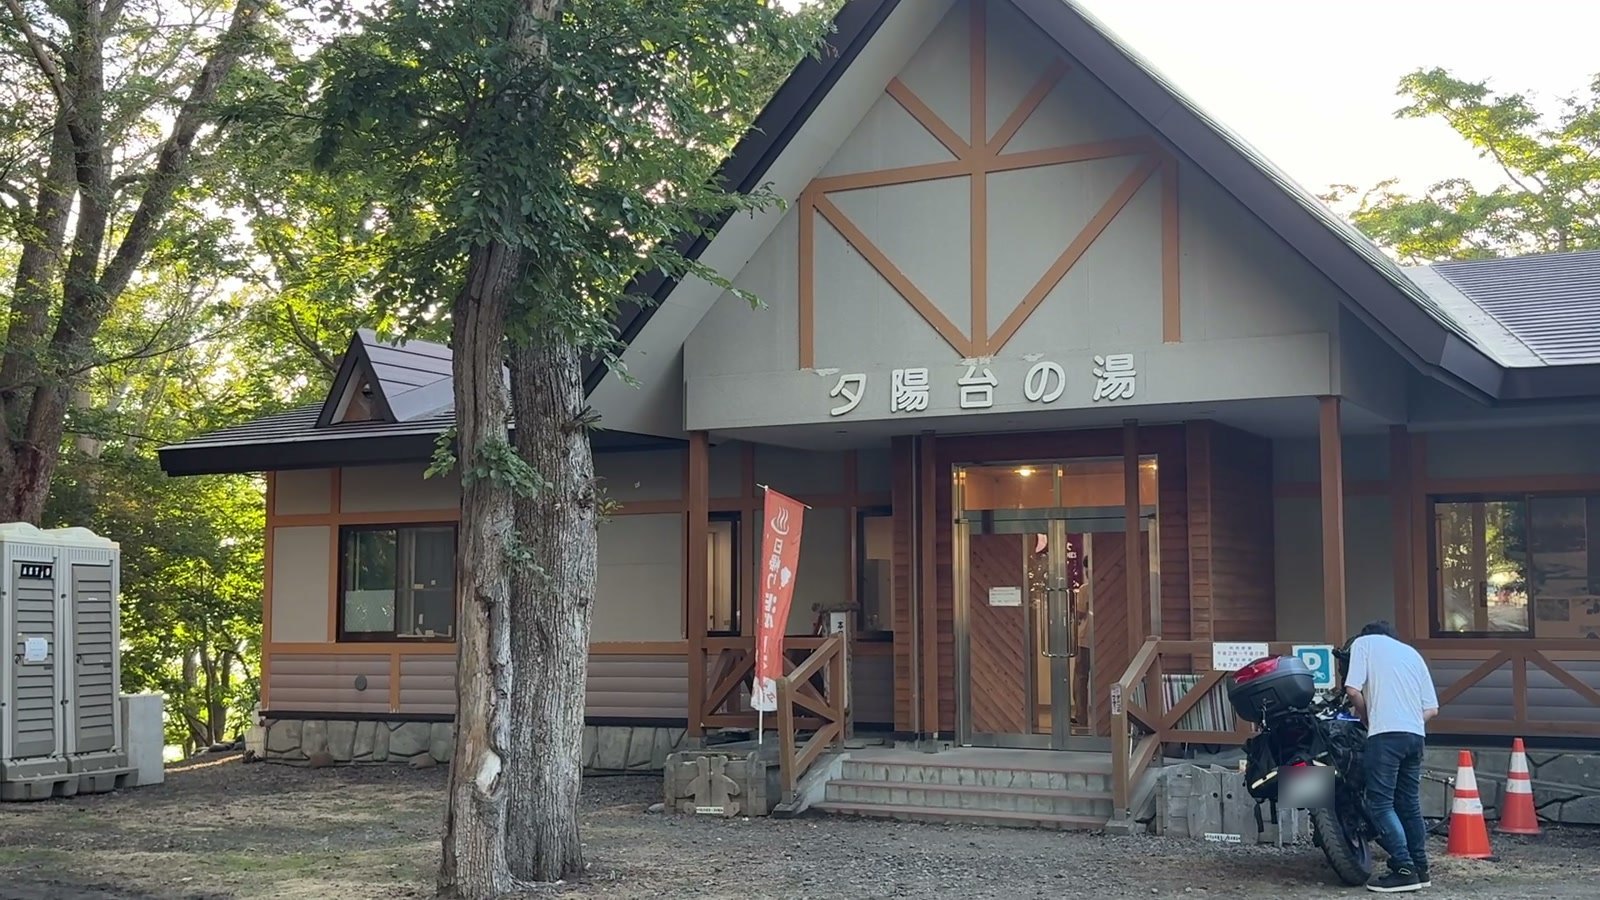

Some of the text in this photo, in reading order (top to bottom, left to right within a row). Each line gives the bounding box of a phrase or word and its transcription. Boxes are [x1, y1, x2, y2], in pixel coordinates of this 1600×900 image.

[829, 353, 1137, 417] 夕陽台の湯
